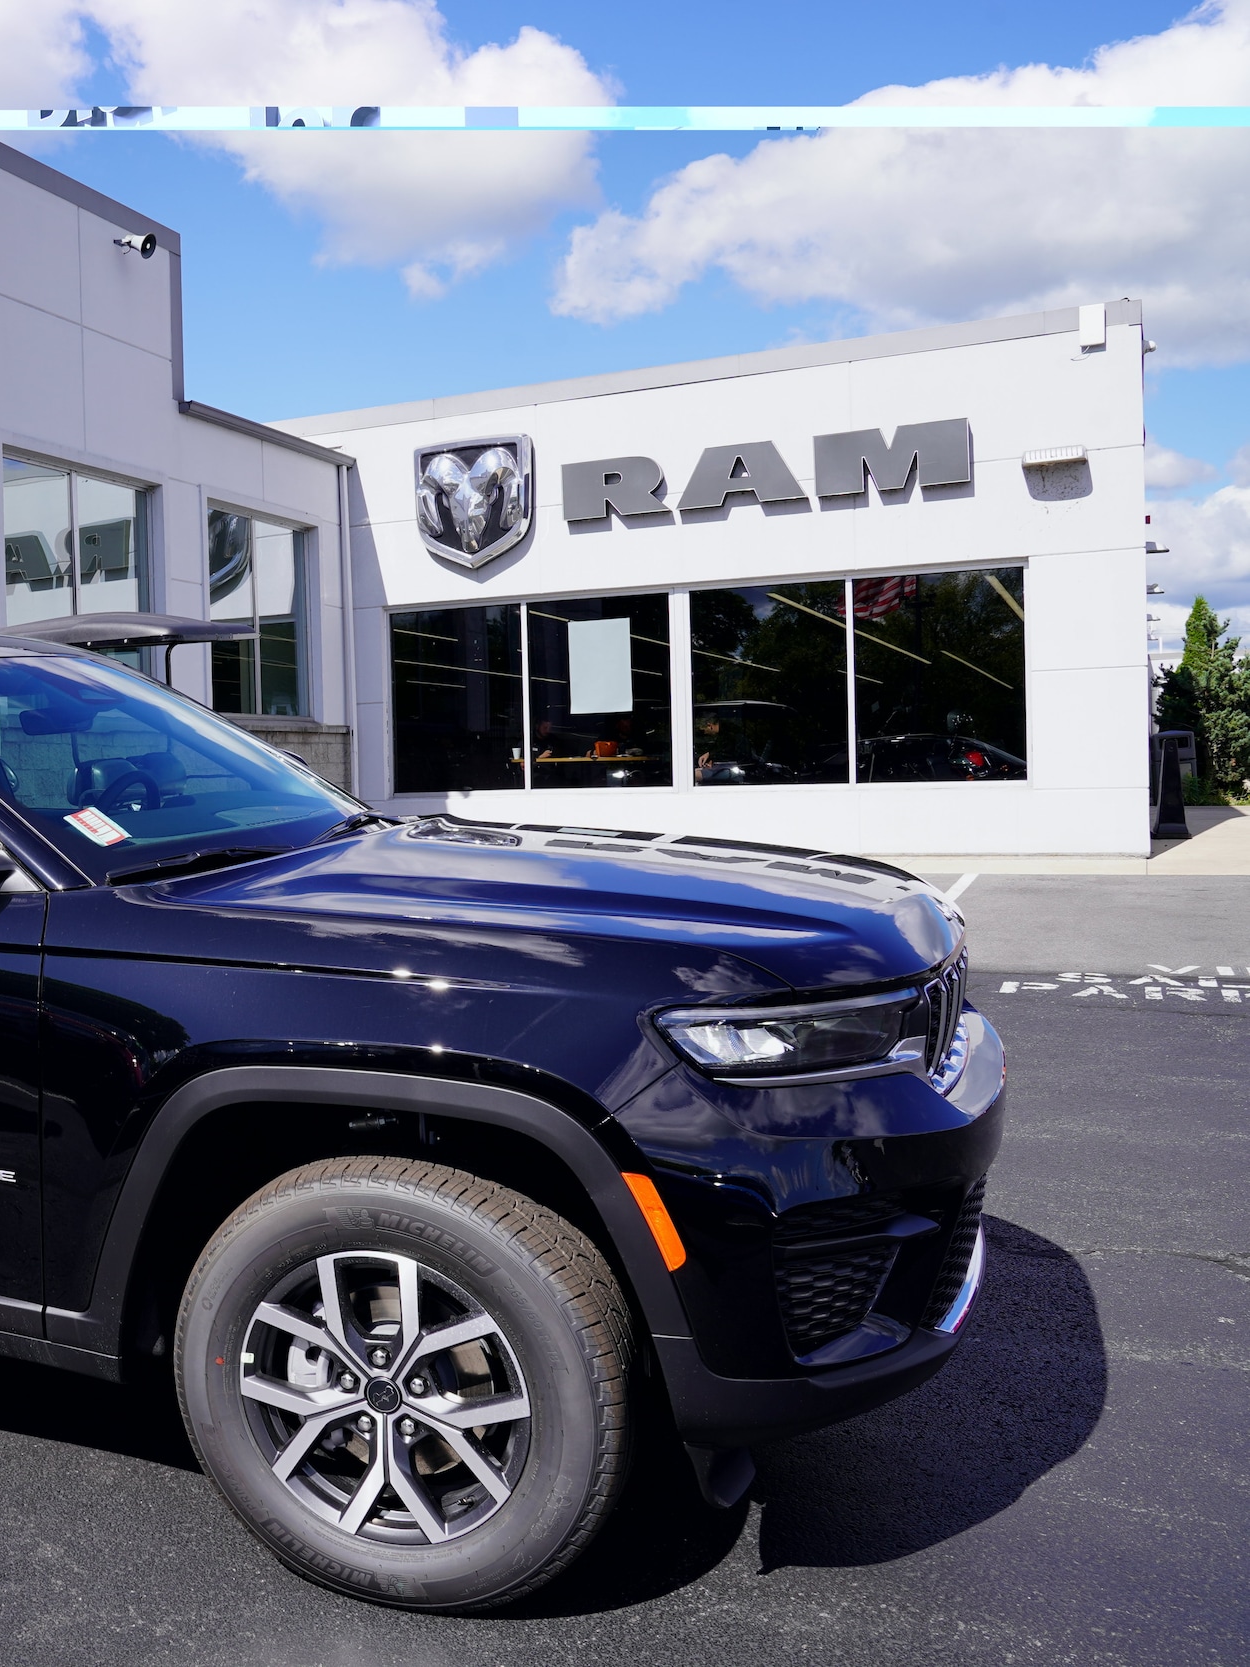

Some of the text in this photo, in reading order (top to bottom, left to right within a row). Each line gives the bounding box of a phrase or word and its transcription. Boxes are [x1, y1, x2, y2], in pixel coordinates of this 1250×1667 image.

[561, 417, 972, 522] RAM
[378, 1212, 493, 1273] MICHELIN
[266, 1521, 372, 1588] MICHELIN
